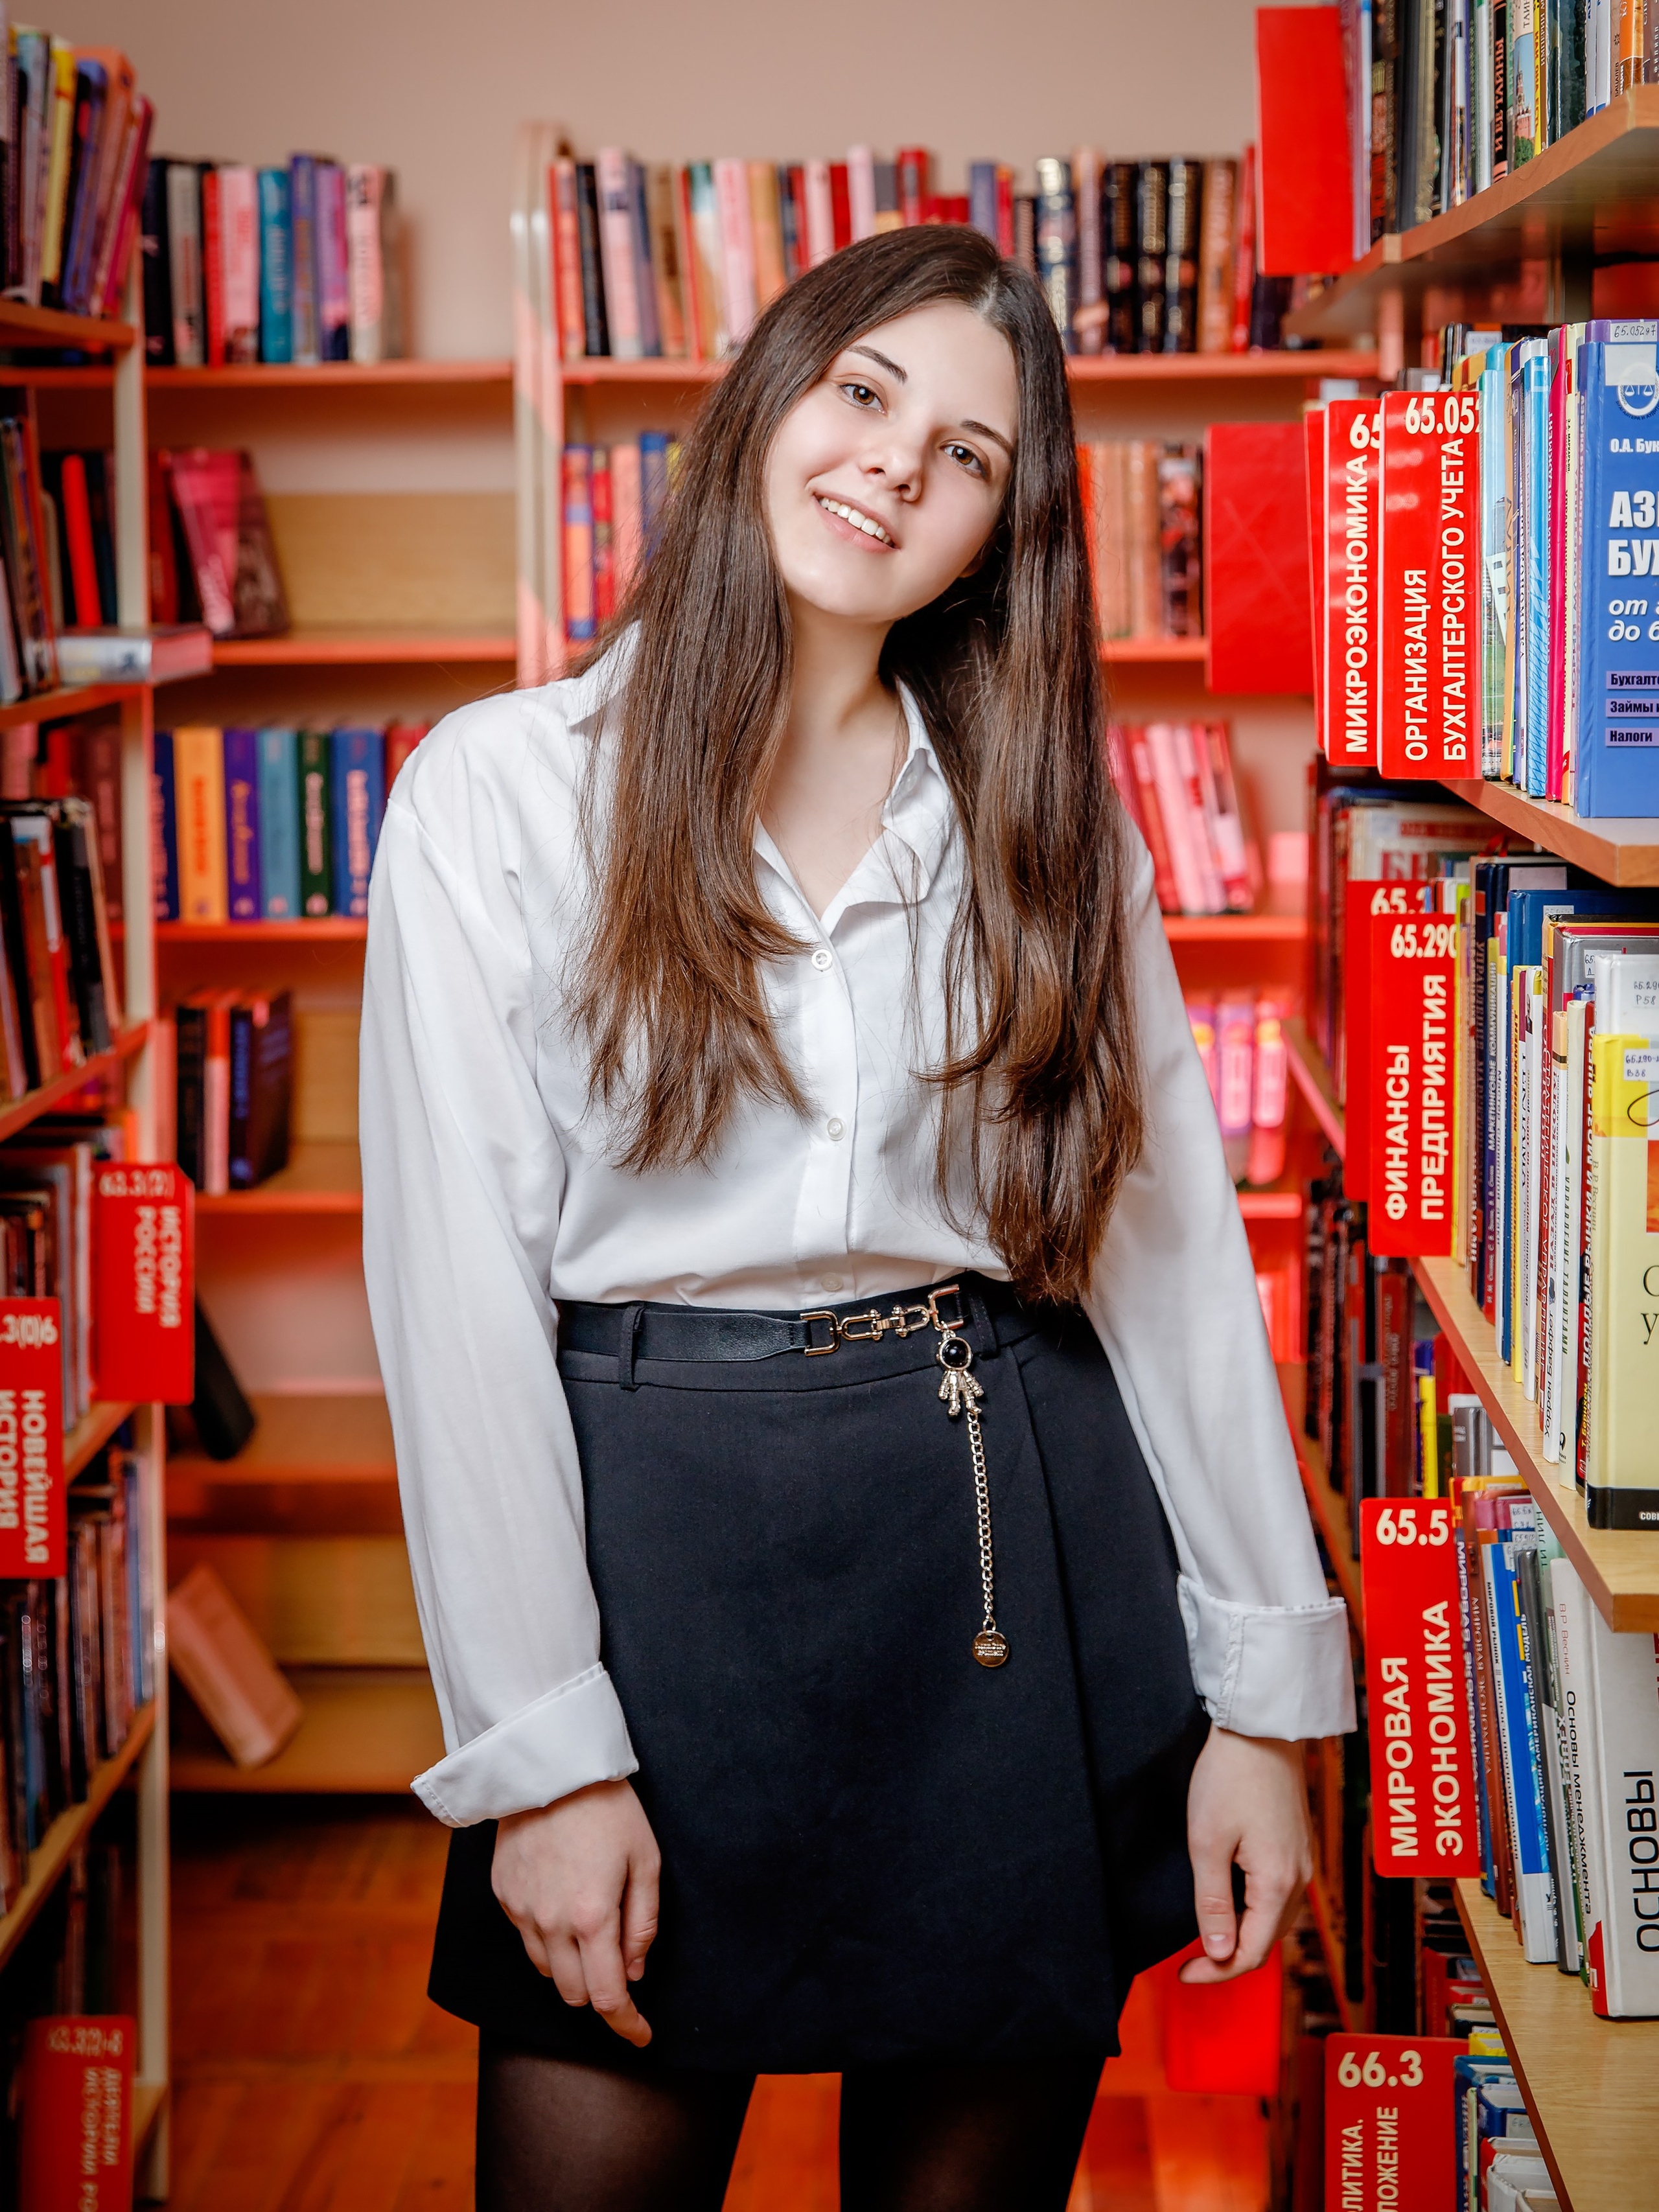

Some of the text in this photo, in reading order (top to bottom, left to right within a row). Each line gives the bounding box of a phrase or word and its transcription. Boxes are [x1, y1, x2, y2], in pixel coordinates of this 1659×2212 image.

[1404, 396, 1480, 435] 65.05
[1611, 438, 1634, 452] О.А.
[1609, 490, 1659, 528] АЗ
[1345, 454, 1367, 753] МИКРОЭКОНОМИКА
[1441, 438, 1466, 761] БУХГАЛТЕРСКОГО УЧЕТА
[1608, 599, 1648, 616] от
[1608, 620, 1640, 641] до
[1404, 570, 1430, 761] ОРГАНИЗАЦИЯ
[1610, 700, 1653, 713] Займы
[1610, 730, 1653, 742] Налоги
[1421, 974, 1449, 1220] ПРЕДПРИЯТИЯ
[1488, 962, 1497, 1151] МАРКЕТИНГОВЫЕ КОММУНИКАЦИИ
[1384, 1045, 1410, 1220] ФИНАНСЫ
[134, 1205, 156, 1314] РОССИИ
[159, 1205, 181, 1328] ИСТОРИЯ
[21, 1389, 52, 1563] НОВЕЙШАЯ
[1376, 1508, 1449, 1546] 65.5
[1520, 1613, 1531, 1662] МОДЕЛЬ
[1561, 1630, 1570, 1675] Веснин
[1381, 1657, 1419, 1857] МИРОВАЯ
[1422, 1600, 1463, 1857] ЭКОНОМИКА
[1623, 1771, 1659, 1952] ОСНОВЫ
[1337, 2049, 1424, 2088] 66.3
[1341, 2119, 1364, 2212] ЛИТИКА.
